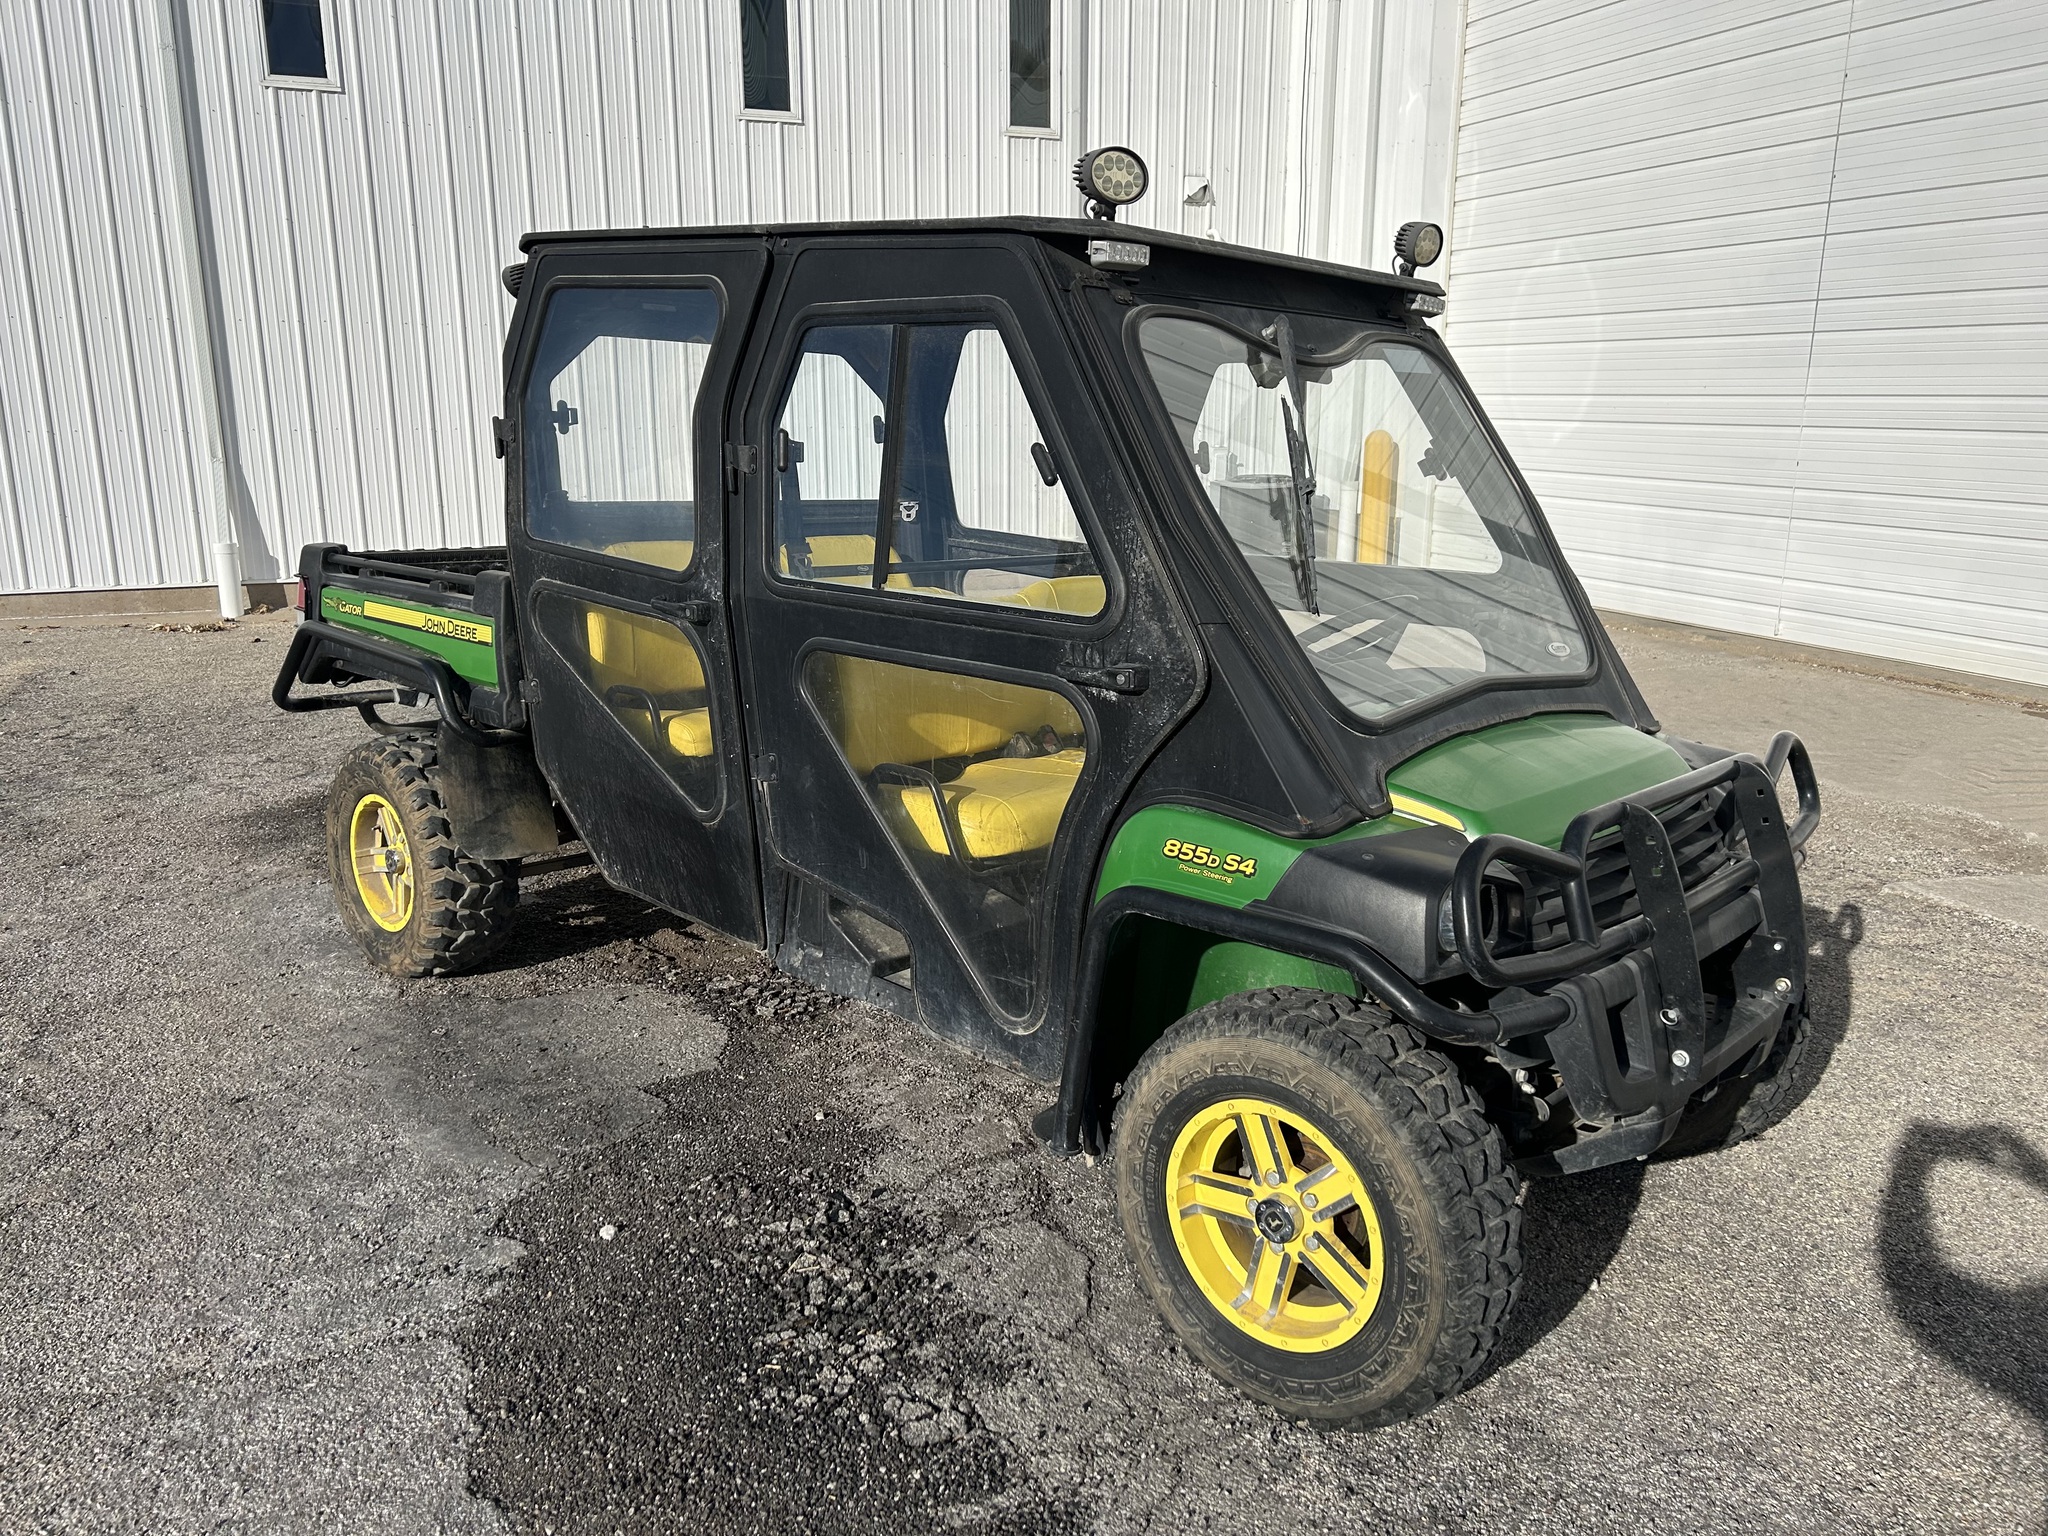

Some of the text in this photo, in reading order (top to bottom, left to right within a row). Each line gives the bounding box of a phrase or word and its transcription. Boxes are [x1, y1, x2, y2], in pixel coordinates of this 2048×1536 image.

[339, 601, 362, 615] GATOR
[421, 615, 477, 640] JOHN DEERE
[1179, 864, 1233, 884] Power Steering
[1222, 853, 1257, 878] S4
